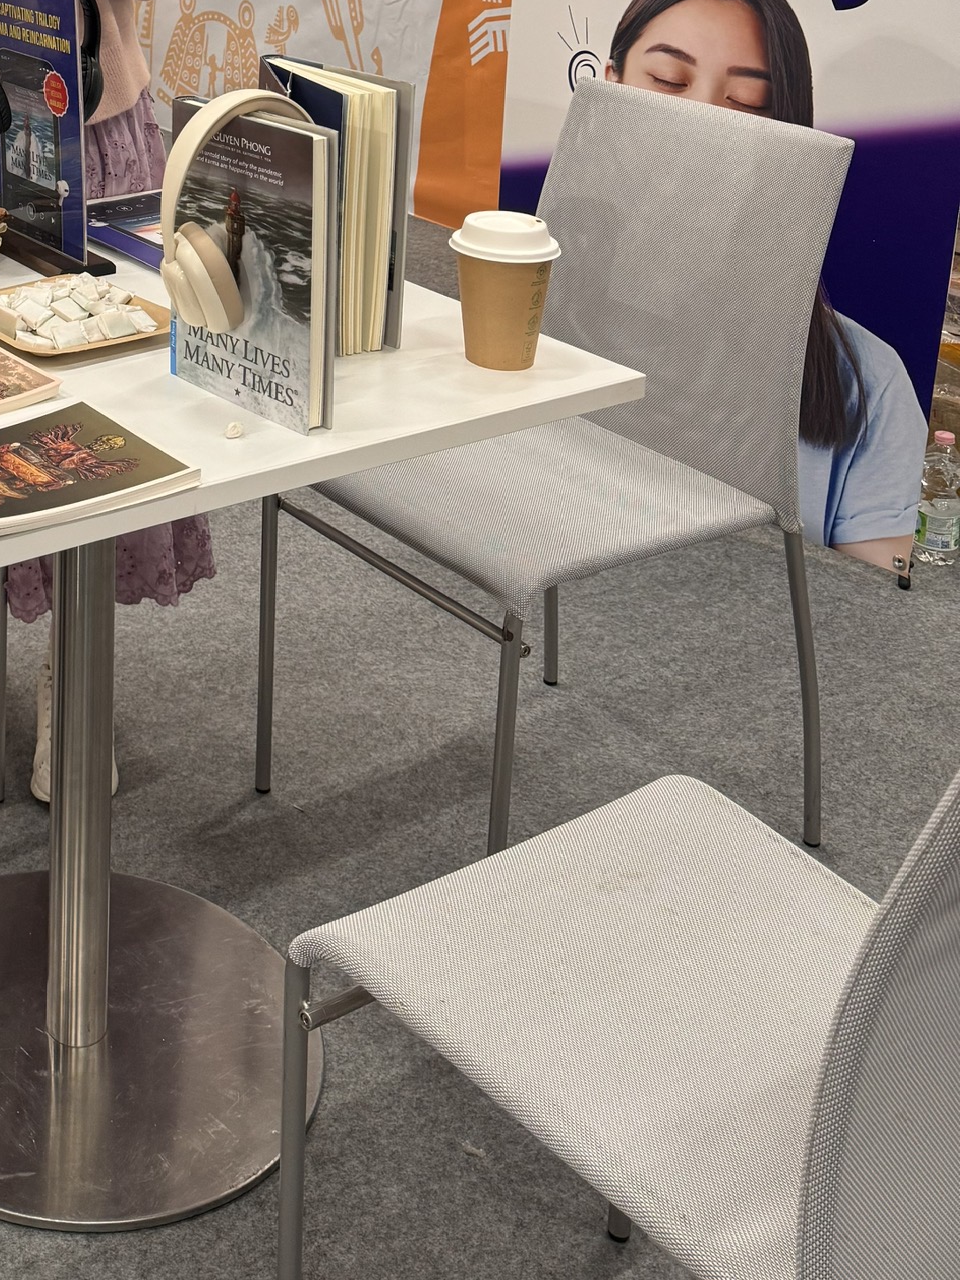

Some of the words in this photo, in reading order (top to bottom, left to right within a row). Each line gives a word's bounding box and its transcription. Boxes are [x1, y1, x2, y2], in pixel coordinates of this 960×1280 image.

[35, 10, 61, 31] TRILOGY
[9, 24, 22, 40] AND
[22, 28, 71, 55] REINCARNATION
[241, 137, 271, 156] PHONG
[249, 162, 257, 171] the
[183, 339, 236, 380] MANY
[187, 324, 240, 355] MANY
[242, 338, 290, 378] LIVES
